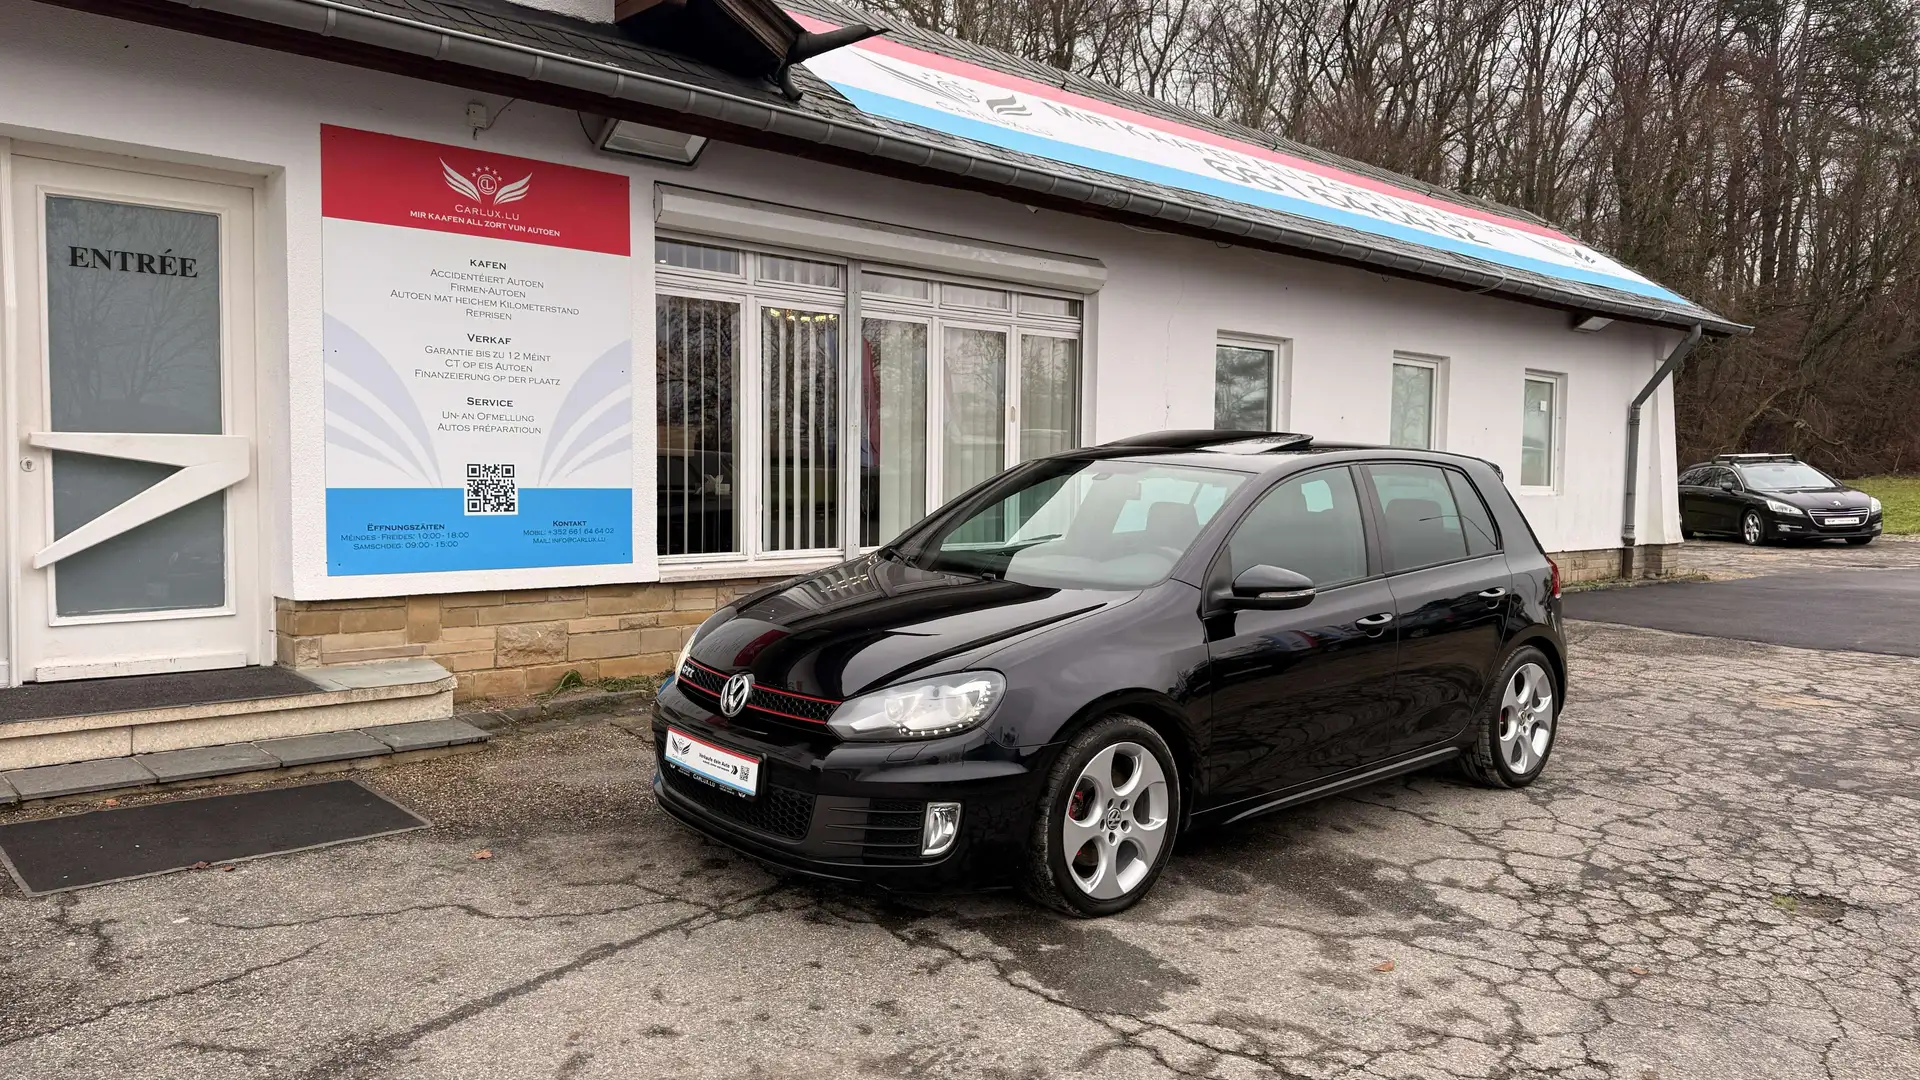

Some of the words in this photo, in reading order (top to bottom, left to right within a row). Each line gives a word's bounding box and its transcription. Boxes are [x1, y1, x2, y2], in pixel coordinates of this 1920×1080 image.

[1040, 101, 1116, 131] MIR
[1115, 120, 1252, 167] KAAFEN
[1252, 158, 1313, 184] ALL
[1203, 158, 1309, 198] 661
[454, 204, 520, 221] CARLUX.LU
[410, 210, 426, 219] MIR
[428, 213, 465, 224] KAAFEN
[466, 218, 483, 227] ALL
[484, 221, 506, 230] ZORT
[508, 224, 526, 232] VUN
[527, 226, 560, 237] AUTOEN
[68, 246, 198, 278] ENTRÉE
[469, 259, 507, 270] KAFEN
[430, 268, 505, 284] ACCIDENTÉIERT
[507, 277, 544, 289] AUTOEN
[450, 282, 526, 298] FIRMEN-AUTOEN
[390, 290, 432, 301] AUTOEN
[434, 295, 452, 303] MAT
[456, 296, 497, 308] HEICHEM
[499, 300, 580, 316] KILOMETERSTAND
[466, 308, 512, 321] REPRISEN
[467, 334, 512, 344] VERKAF
[424, 346, 473, 357] GARANTIE
[476, 350, 491, 358] BIS
[508, 352, 520, 360] 12
[523, 353, 551, 362] MÉINT
[445, 359, 460, 368] CT
[463, 361, 476, 369] OP
[478, 362, 493, 370] EIS
[495, 362, 533, 372] AUTOEN
[414, 369, 490, 382] FINANZEIERUNG
[508, 376, 526, 384] DER
[529, 378, 561, 386] PLAATZ
[466, 397, 514, 407] SERVICE
[442, 411, 459, 420] UN-
[477, 412, 535, 422] OFMELLUNG
[438, 423, 470, 432] AUTOS
[472, 424, 541, 434] PRÉPARATIOUN
